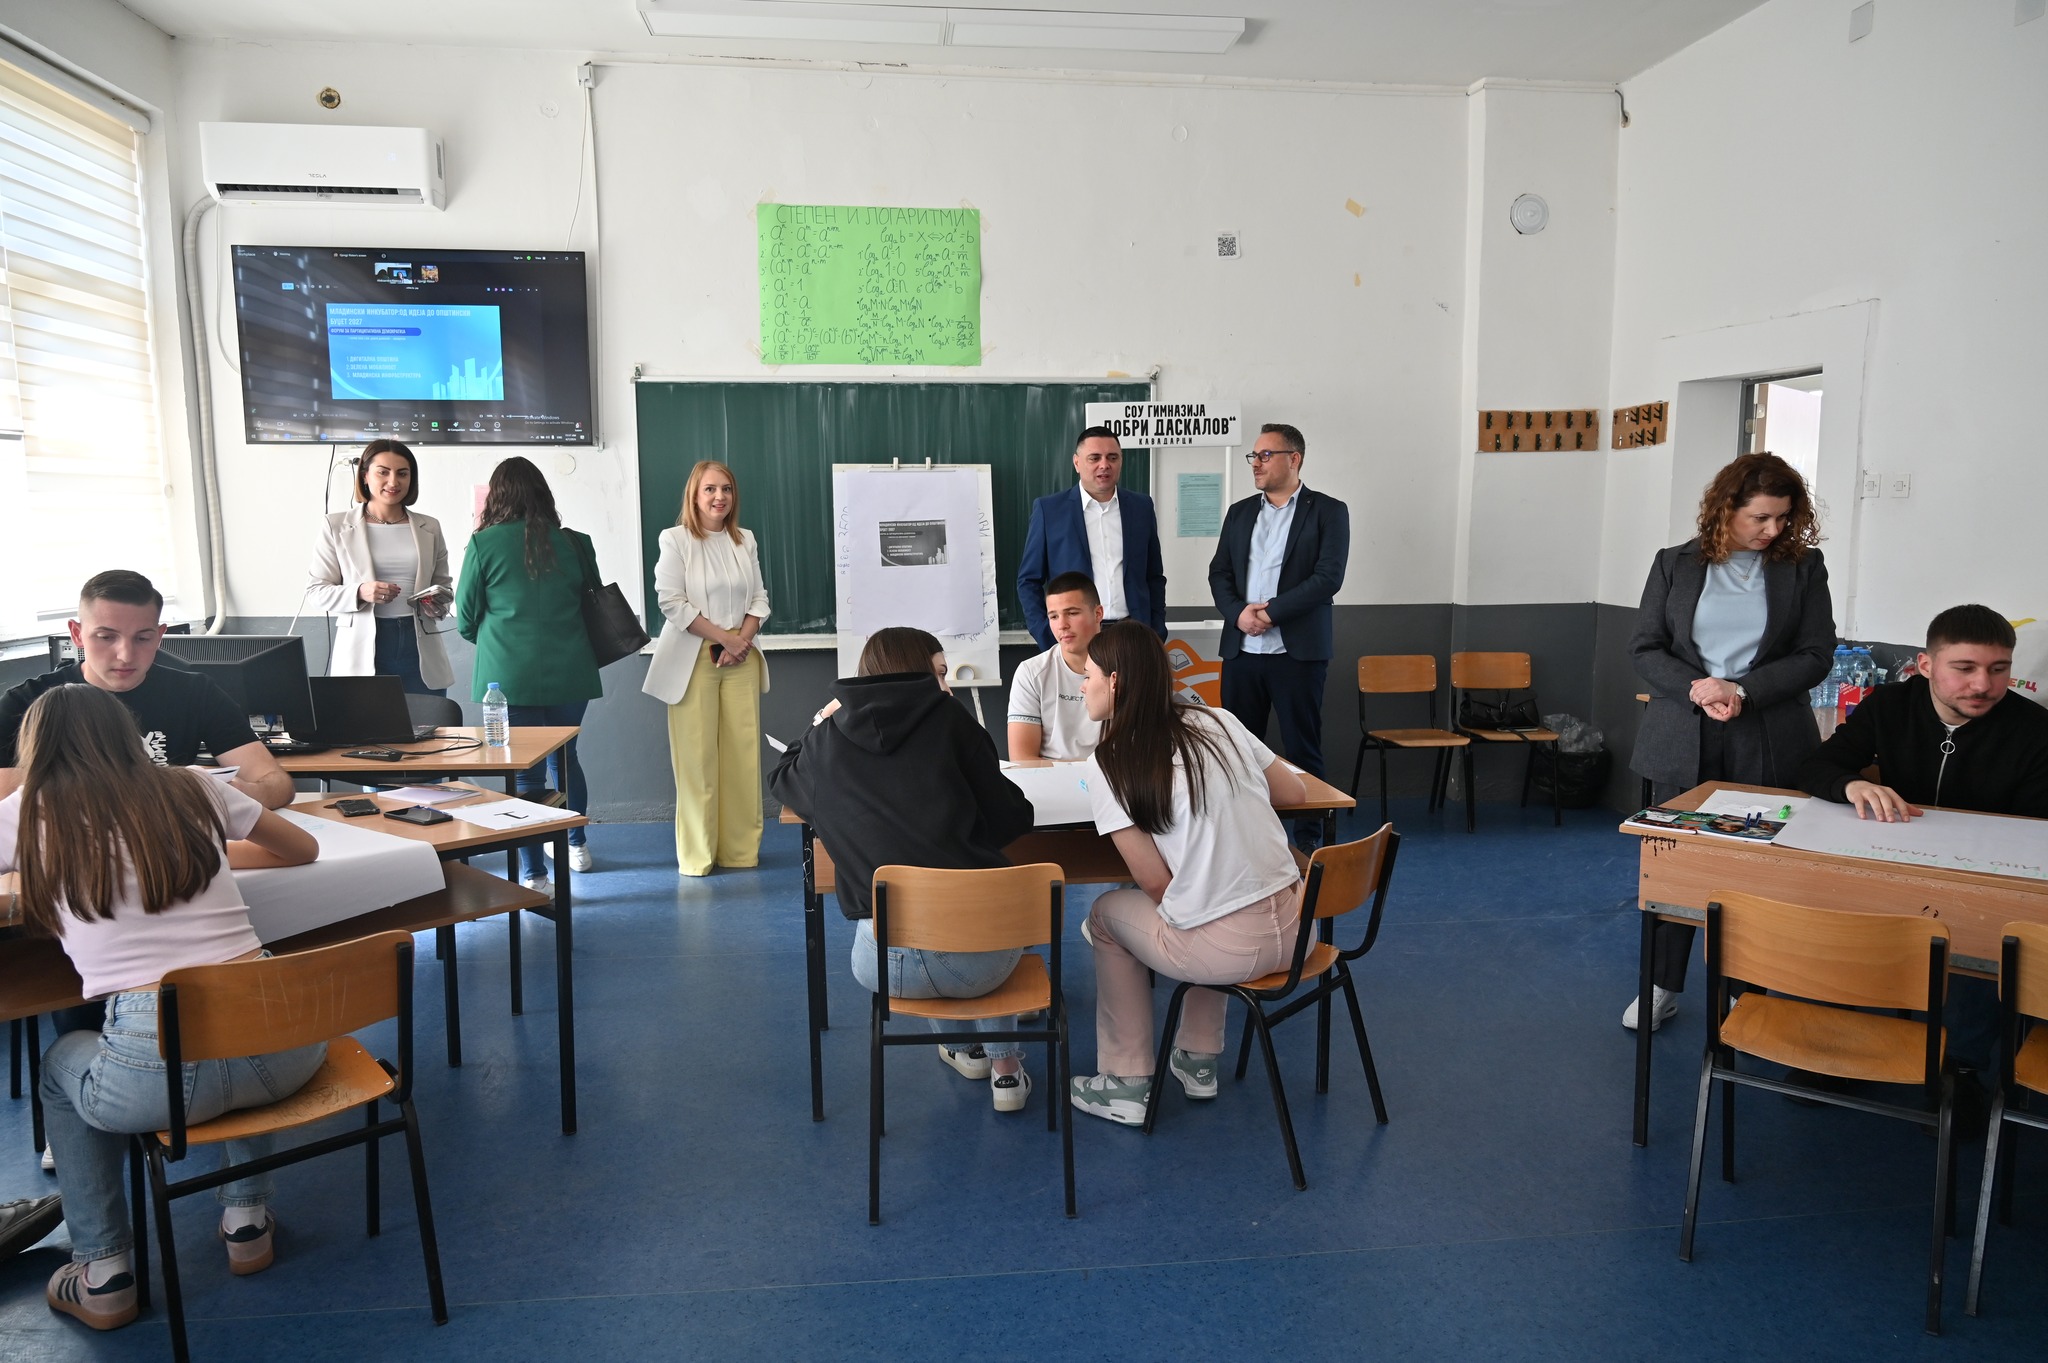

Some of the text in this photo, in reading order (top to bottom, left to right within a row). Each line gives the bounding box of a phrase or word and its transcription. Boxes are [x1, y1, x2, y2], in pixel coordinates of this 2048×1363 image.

[777, 205, 965, 227] СТЕПЕН И ЛОГАРИТМИ
[330, 308, 365, 316] МЛАДИНСКИ
[1125, 404, 1206, 418] СОУ ГИМНАЗИЈА
[1138, 437, 1193, 447] КАВАДАРЦИ
